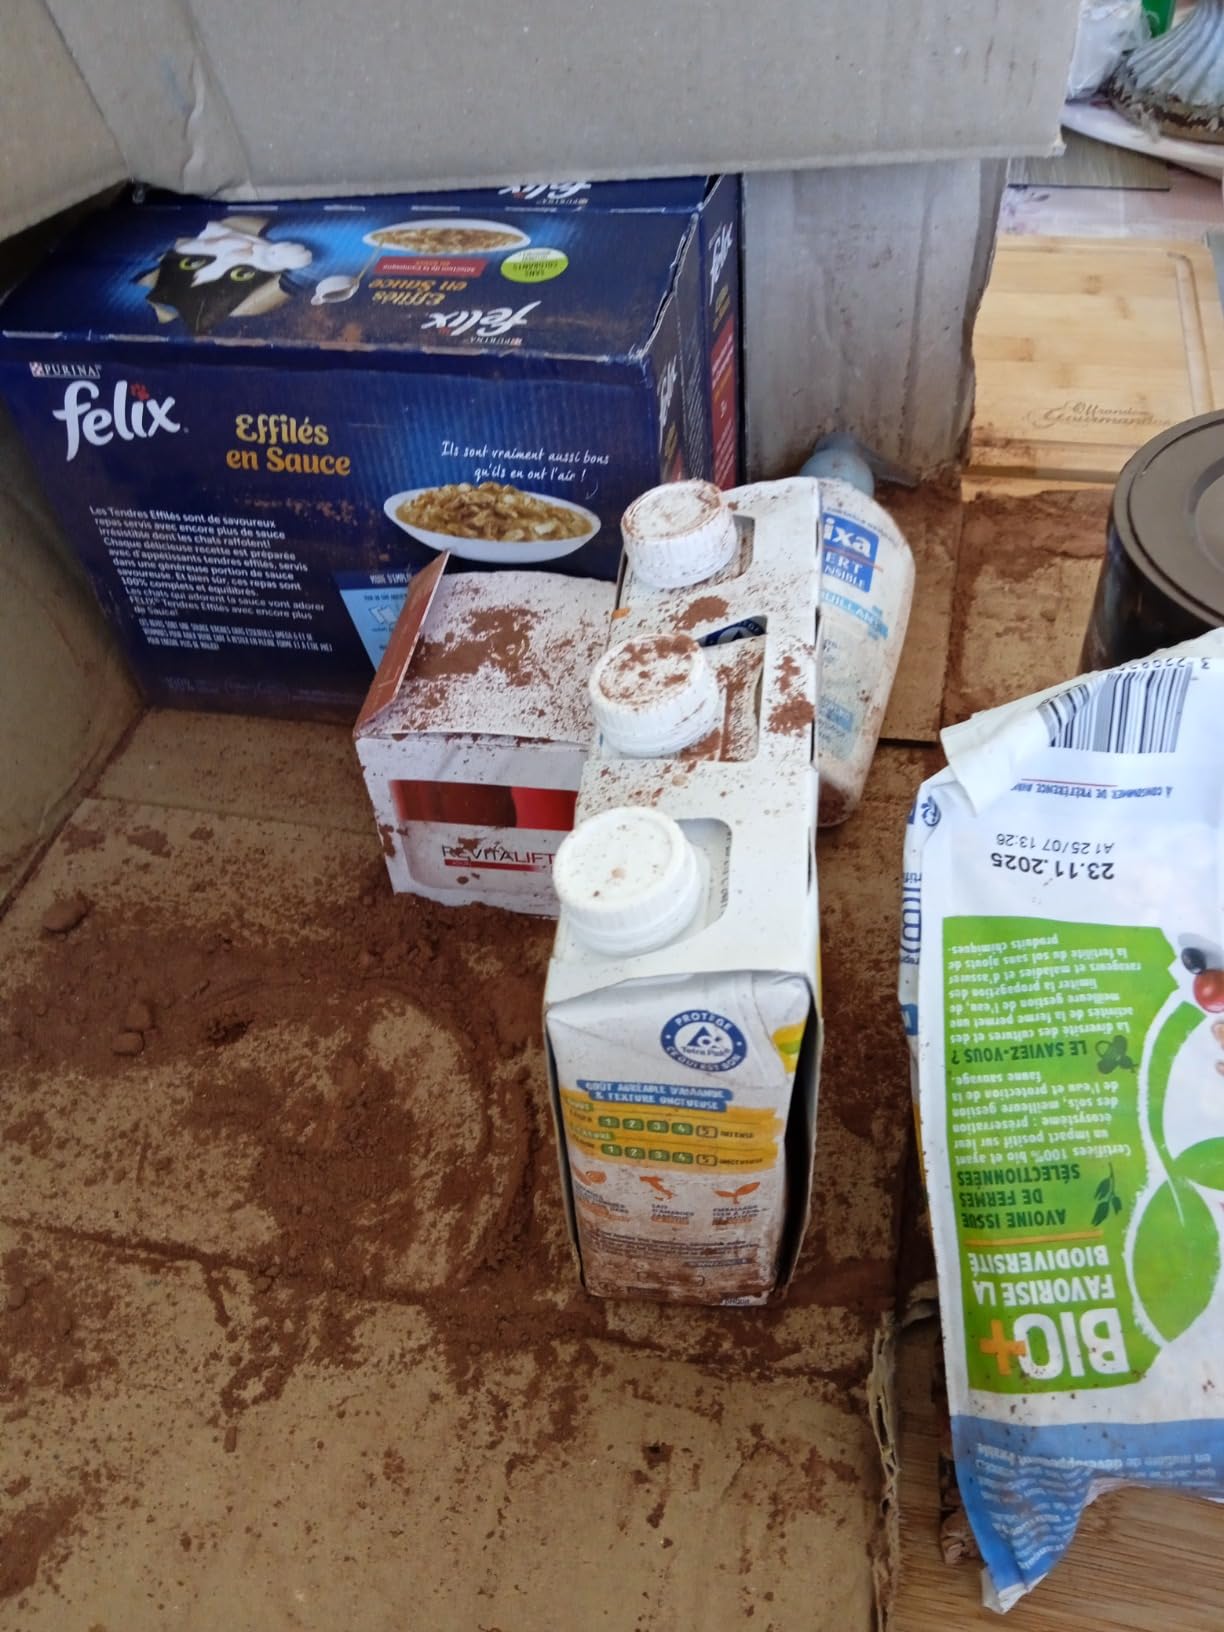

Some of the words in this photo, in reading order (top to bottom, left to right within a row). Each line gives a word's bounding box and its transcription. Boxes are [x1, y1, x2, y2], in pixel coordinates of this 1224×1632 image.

[421, 300, 542, 337] felix
[44, 364, 98, 377] PURINA
[52, 380, 181, 462] felix
[235, 414, 330, 445] Effilés
[441, 440, 458, 457] Ils
[464, 444, 488, 458] sont
[491, 448, 544, 460] vraiment
[548, 451, 580, 463] aussi
[583, 449, 611, 464] bons
[226, 449, 258, 470] en
[266, 447, 351, 476] Sauce
[510, 470, 524, 479] en
[527, 468, 547, 480] ont
[996, 833, 1035, 850] 13:26
[1042, 838, 1091, 854] 25/07
[1095, 842, 1114, 854] A1
[990, 852, 1115, 880] 23.11.2025
[1003, 1000, 1016, 1012] de
[964, 1042, 1065, 1062] SAVIEZ-VOUS
[1070, 1040, 1087, 1055] LE
[950, 1050, 960, 1065] ?
[955, 1152, 986, 1166] ayant
[990, 1153, 1003, 1165] et
[1007, 1151, 1027, 1164] bio
[1030, 1148, 1068, 1163] 100%
[956, 1163, 1080, 1188] SÉLECTIONNÉES
[959, 1190, 1016, 1207] FERMES
[1022, 1188, 1043, 1204] DE
[961, 1212, 1000, 1229] ISSUE
[1006, 1208, 1066, 1228] AVOINE
[968, 1245, 1110, 1276] BIODIVERSITÉ
[972, 1280, 997, 1307] LA
[1000, 1274, 1116, 1307] FAVORISE
[980, 1307, 1131, 1380] BIO+
